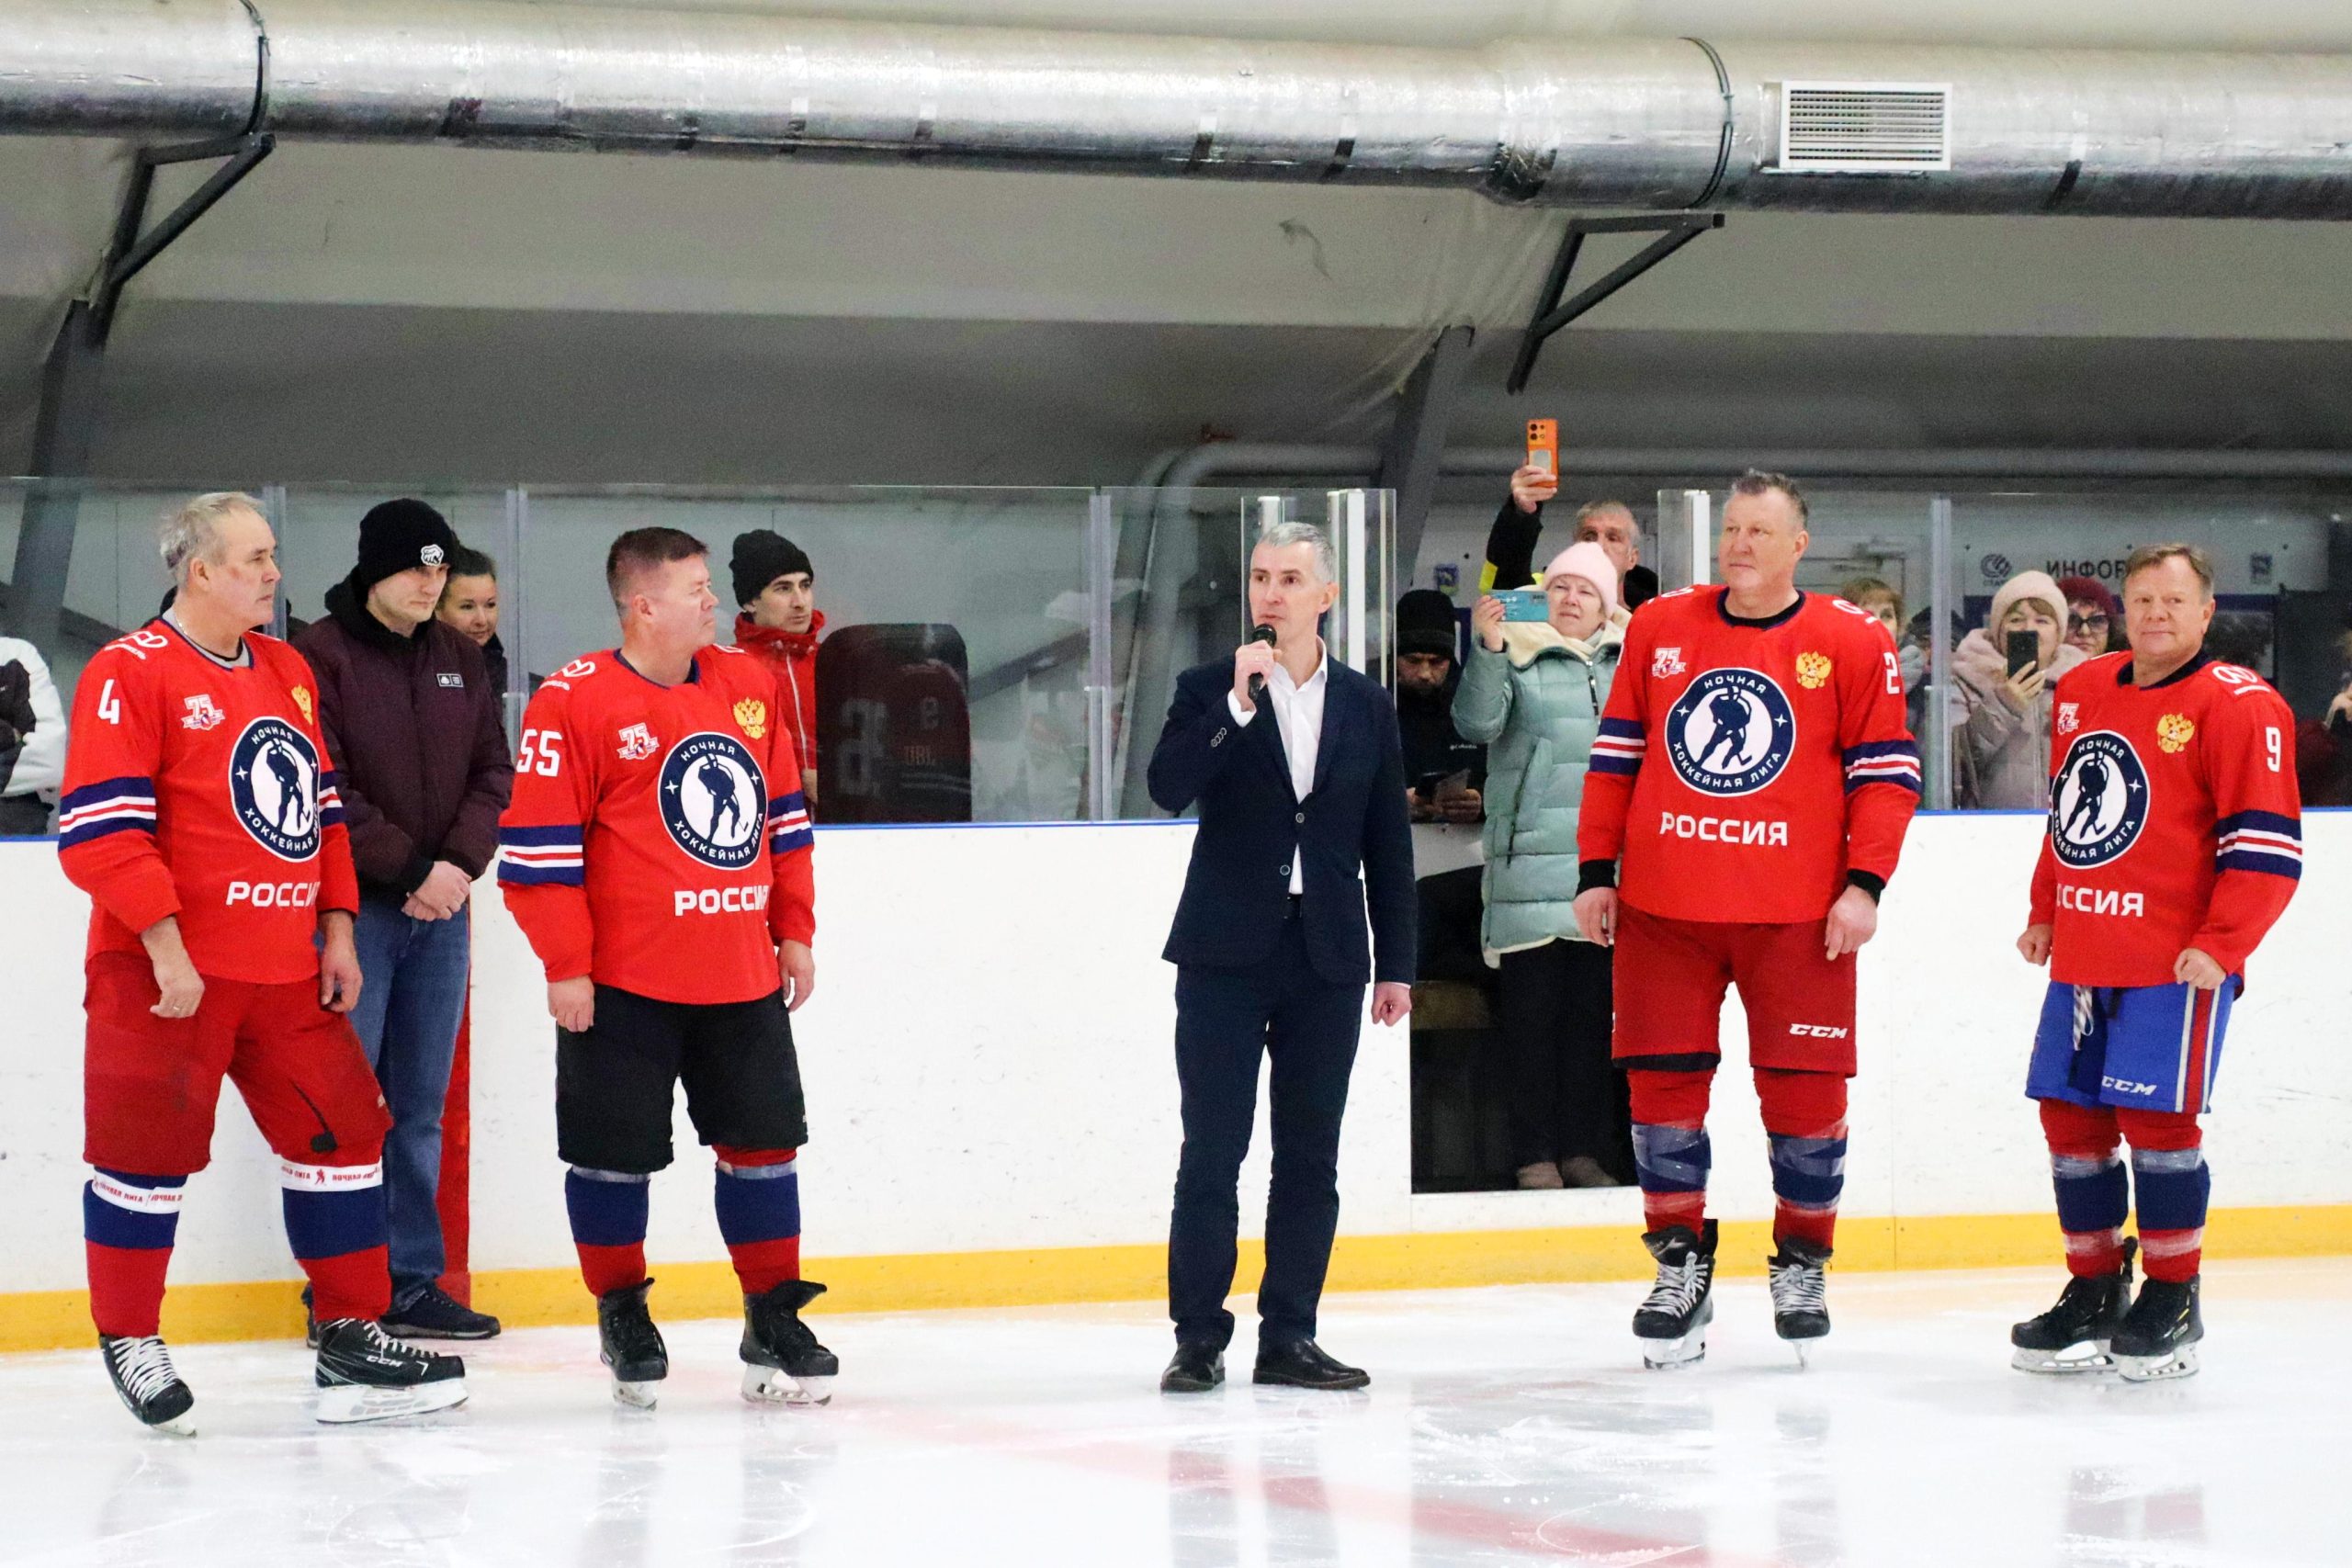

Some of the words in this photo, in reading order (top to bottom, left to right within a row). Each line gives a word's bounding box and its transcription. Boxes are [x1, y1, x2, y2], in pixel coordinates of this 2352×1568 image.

[2046, 559, 2127, 579] ИНФОР
[1655, 648, 1680, 667] 75
[1703, 675, 1767, 694] НОЧНАЯ
[1883, 651, 1900, 694] 2
[97, 679, 120, 724] 4
[185, 694, 213, 720] 75
[251, 726, 293, 745] НОЧНАЯ
[619, 723, 650, 750] 75
[516, 728, 562, 777] 55
[681, 740, 735, 761] НОЧНАЯ
[2078, 739, 2124, 760] НОЧНАЯ
[2266, 727, 2281, 773] 9
[1673, 741, 1743, 788] ХОККЕЙНАЯ
[1750, 752, 1781, 783] ЛИГА
[244, 808, 313, 852] ХОККЕЙНАЯ
[674, 820, 751, 861] ХОККЕЙНАЯ
[1659, 811, 1788, 846] РОССИЯ
[2104, 820, 2135, 852] ЛИГА
[1789, 1022, 1849, 1039] CCM
[2101, 1075, 2157, 1095] CCM
